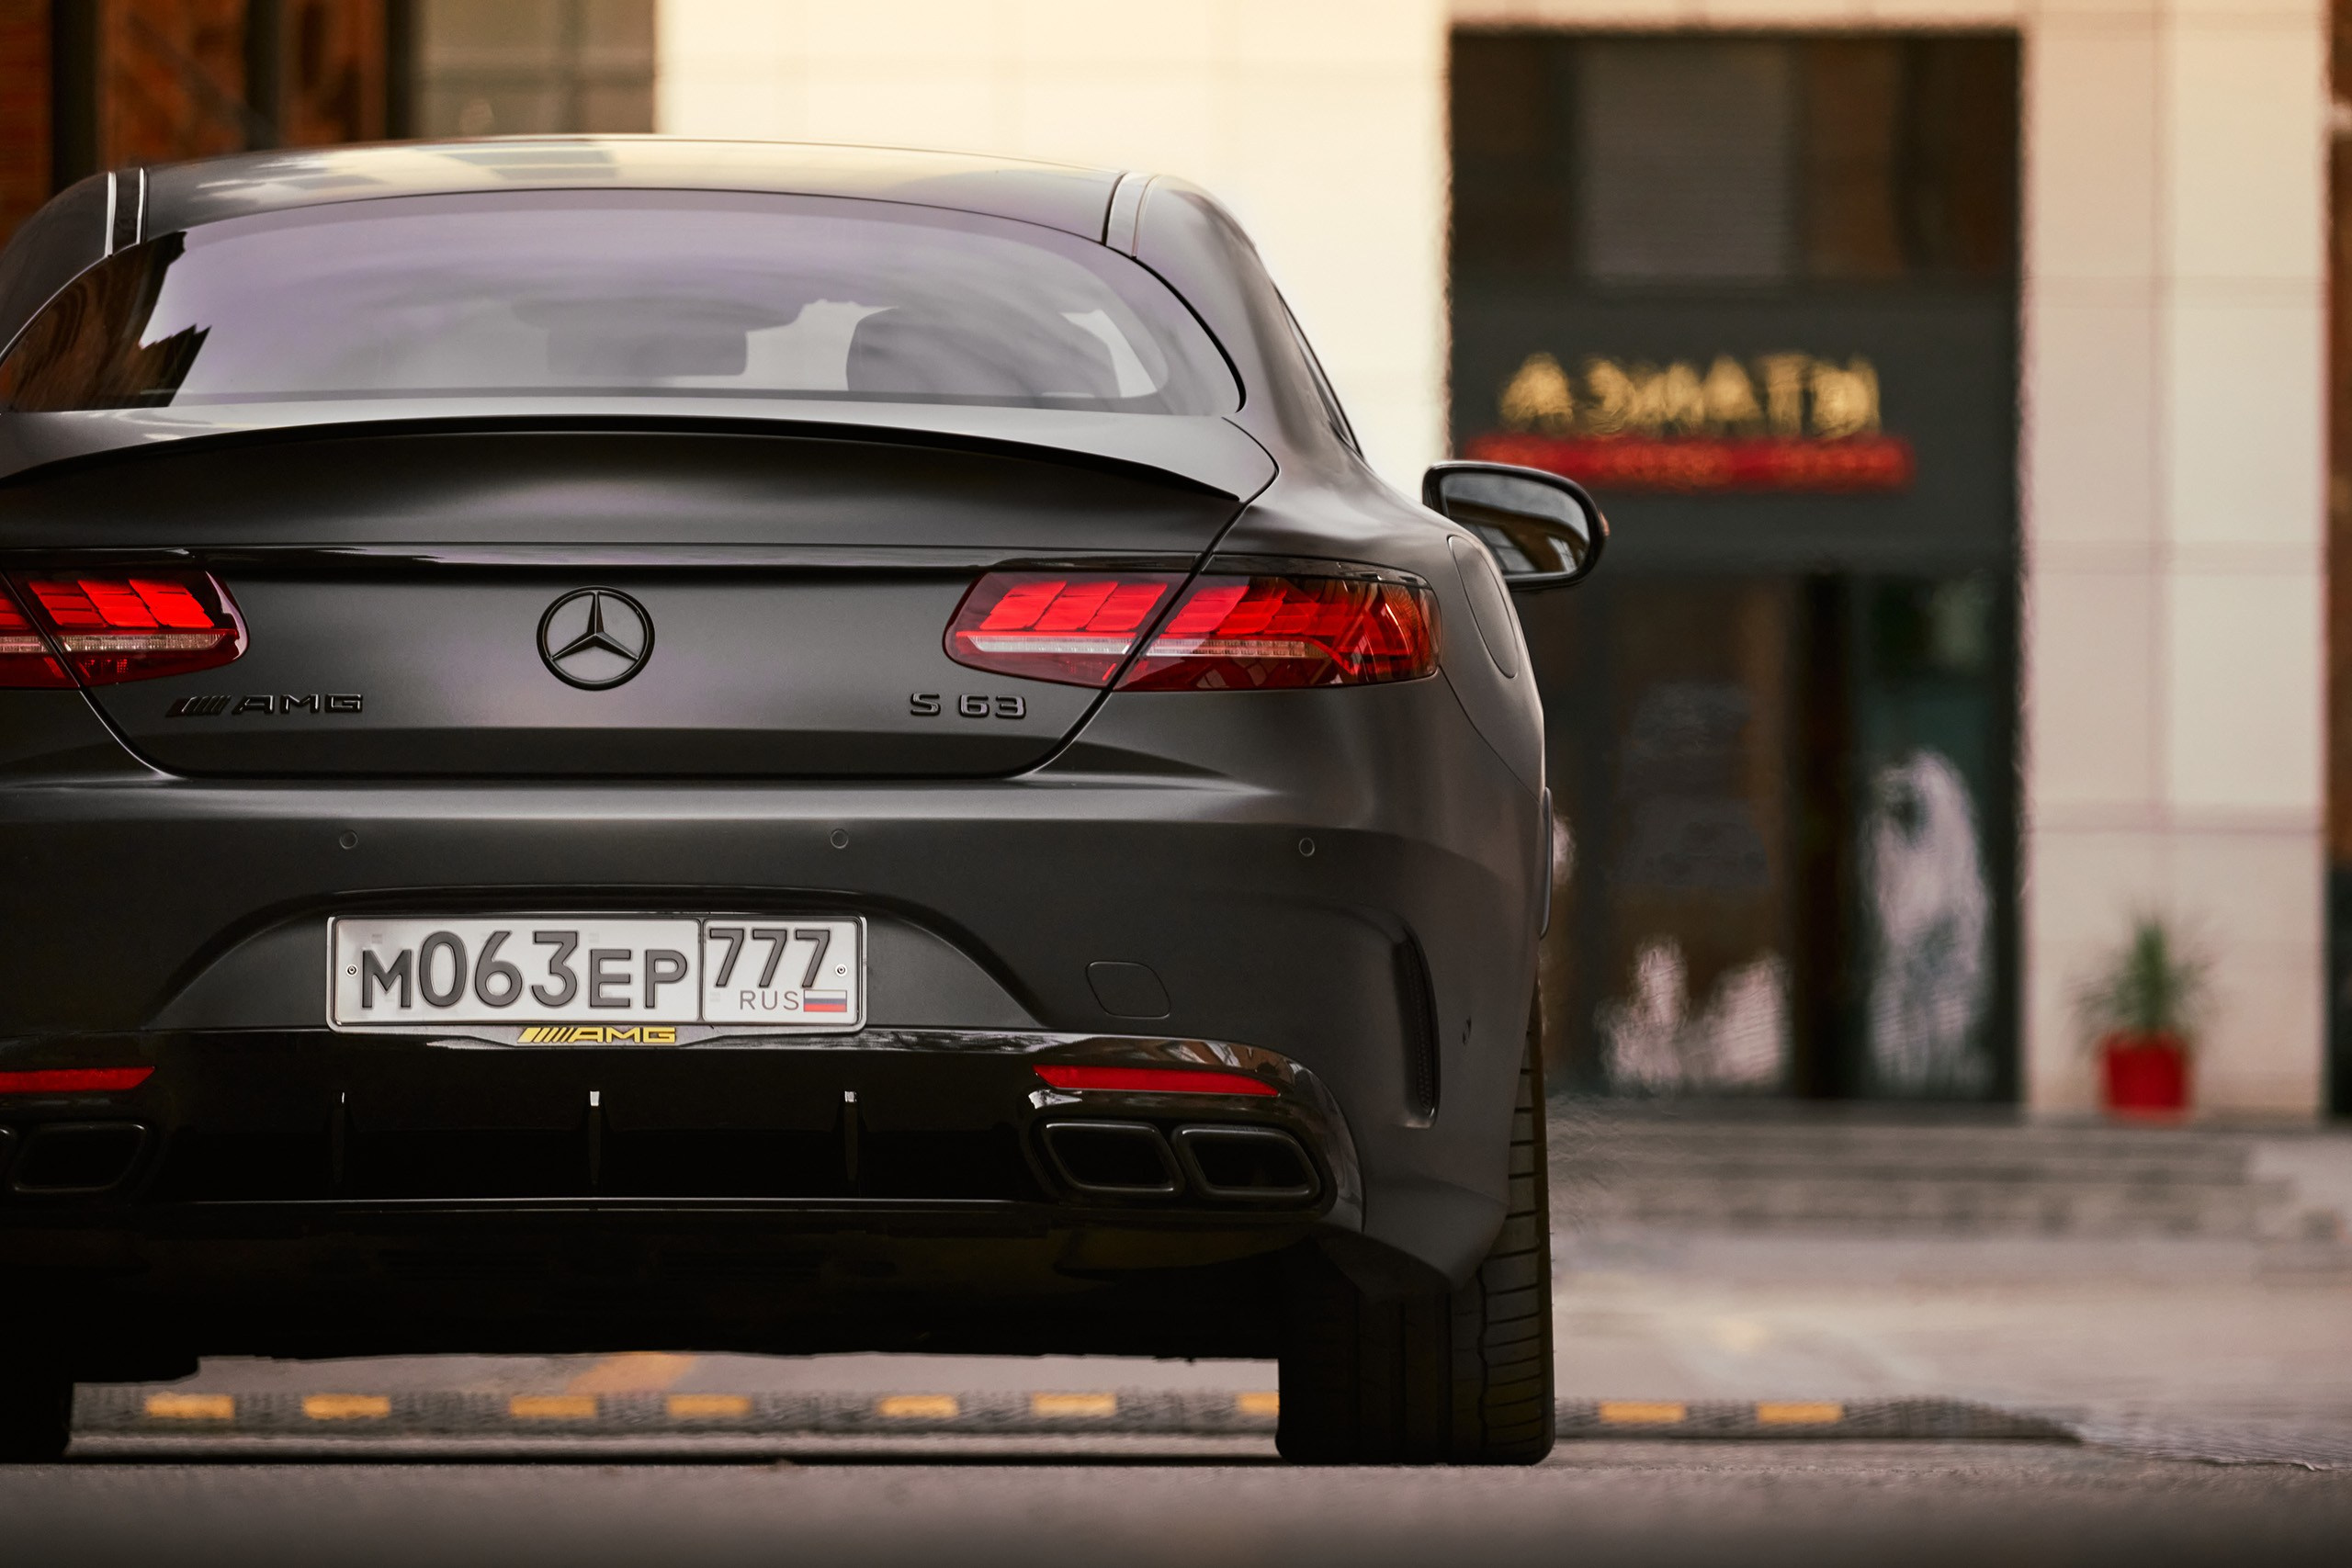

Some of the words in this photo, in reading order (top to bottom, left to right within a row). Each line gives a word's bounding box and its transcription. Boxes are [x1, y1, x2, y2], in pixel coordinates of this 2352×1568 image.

[231, 694, 364, 715] AMG
[910, 693, 942, 716] S
[958, 694, 1027, 720] 63
[707, 928, 833, 988] 777
[739, 989, 800, 1011] RUS
[566, 1026, 677, 1044] AMG
